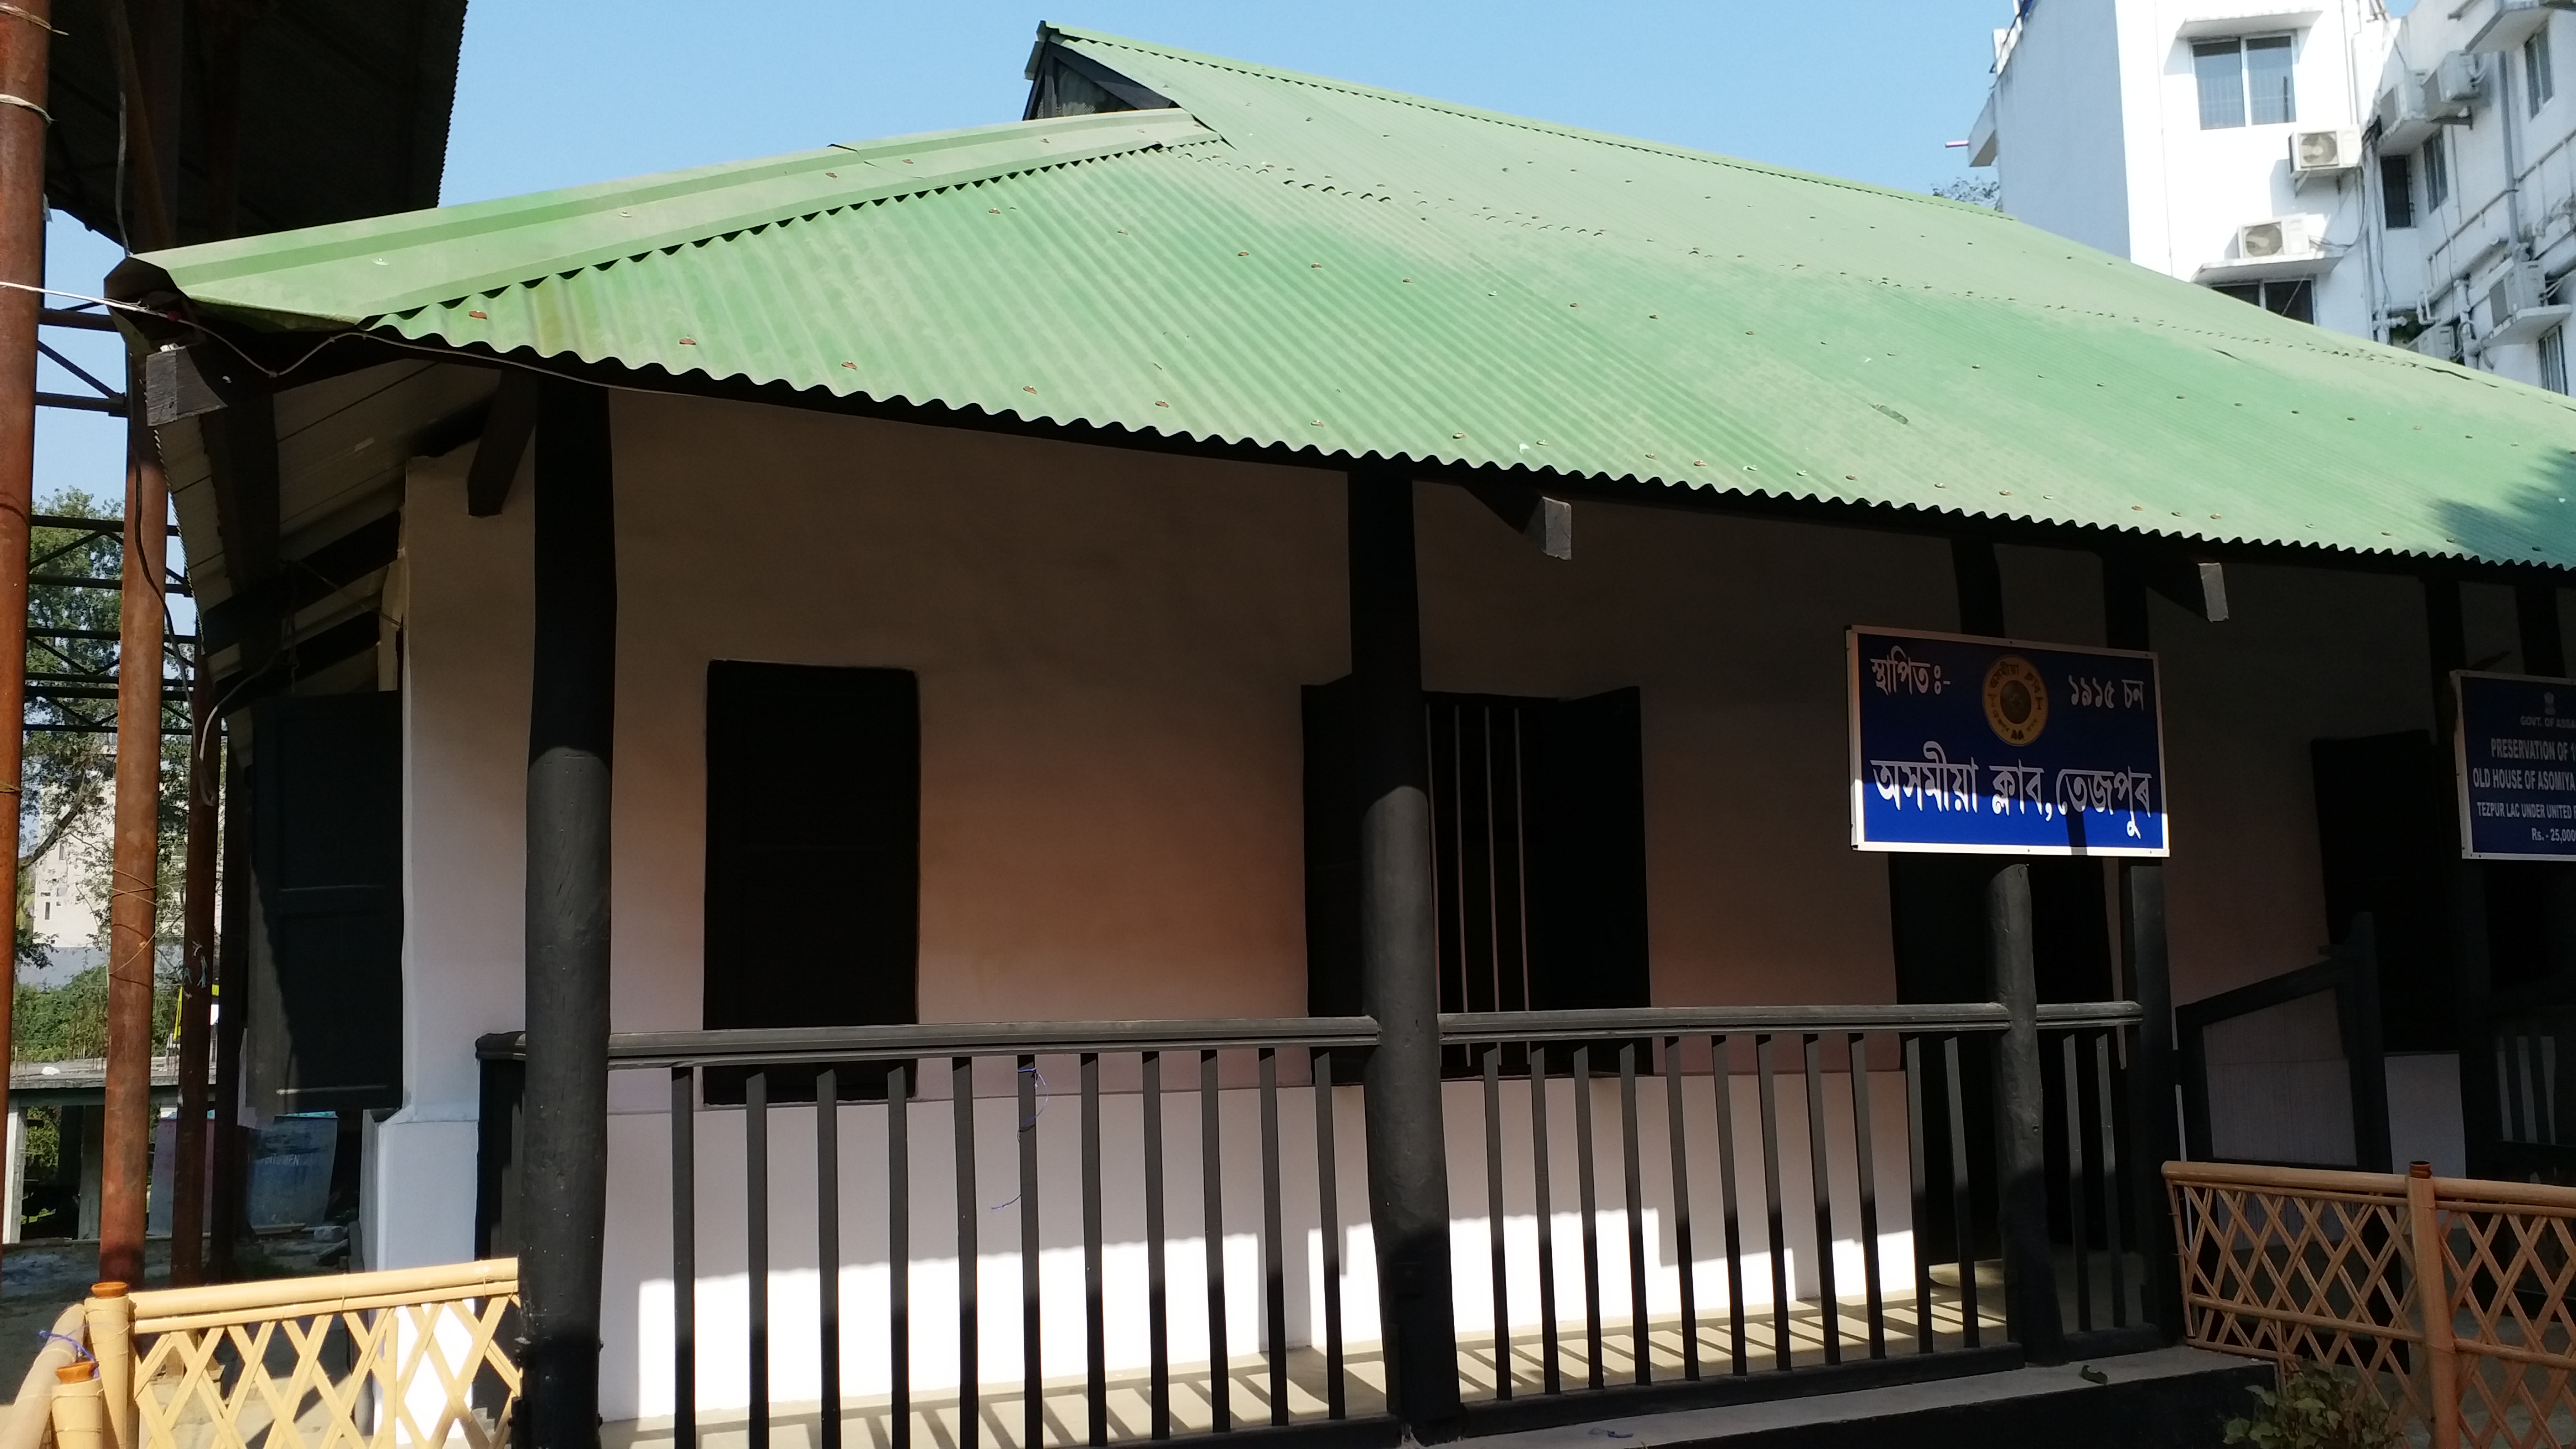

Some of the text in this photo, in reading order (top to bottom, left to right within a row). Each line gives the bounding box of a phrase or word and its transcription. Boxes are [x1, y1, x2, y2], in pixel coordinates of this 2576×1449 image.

[2068, 675, 2144, 711] ১৯১৫ চন
[2545, 717, 2554, 727] OF
[2490, 738, 2555, 761] PRESERVATION
[2557, 741, 2568, 762] OF
[1870, 741, 1980, 813] অসমীয়া
[2473, 768, 2575, 791] OLD HOUSE OF ASOMIYA
[2477, 802, 2505, 818] TEZPUR
[2506, 803, 2520, 818] LAC
[2522, 803, 2545, 818] UNDER
[2546, 804, 2572, 820] UNITED
[2550, 828, 2576, 845] 25,000
